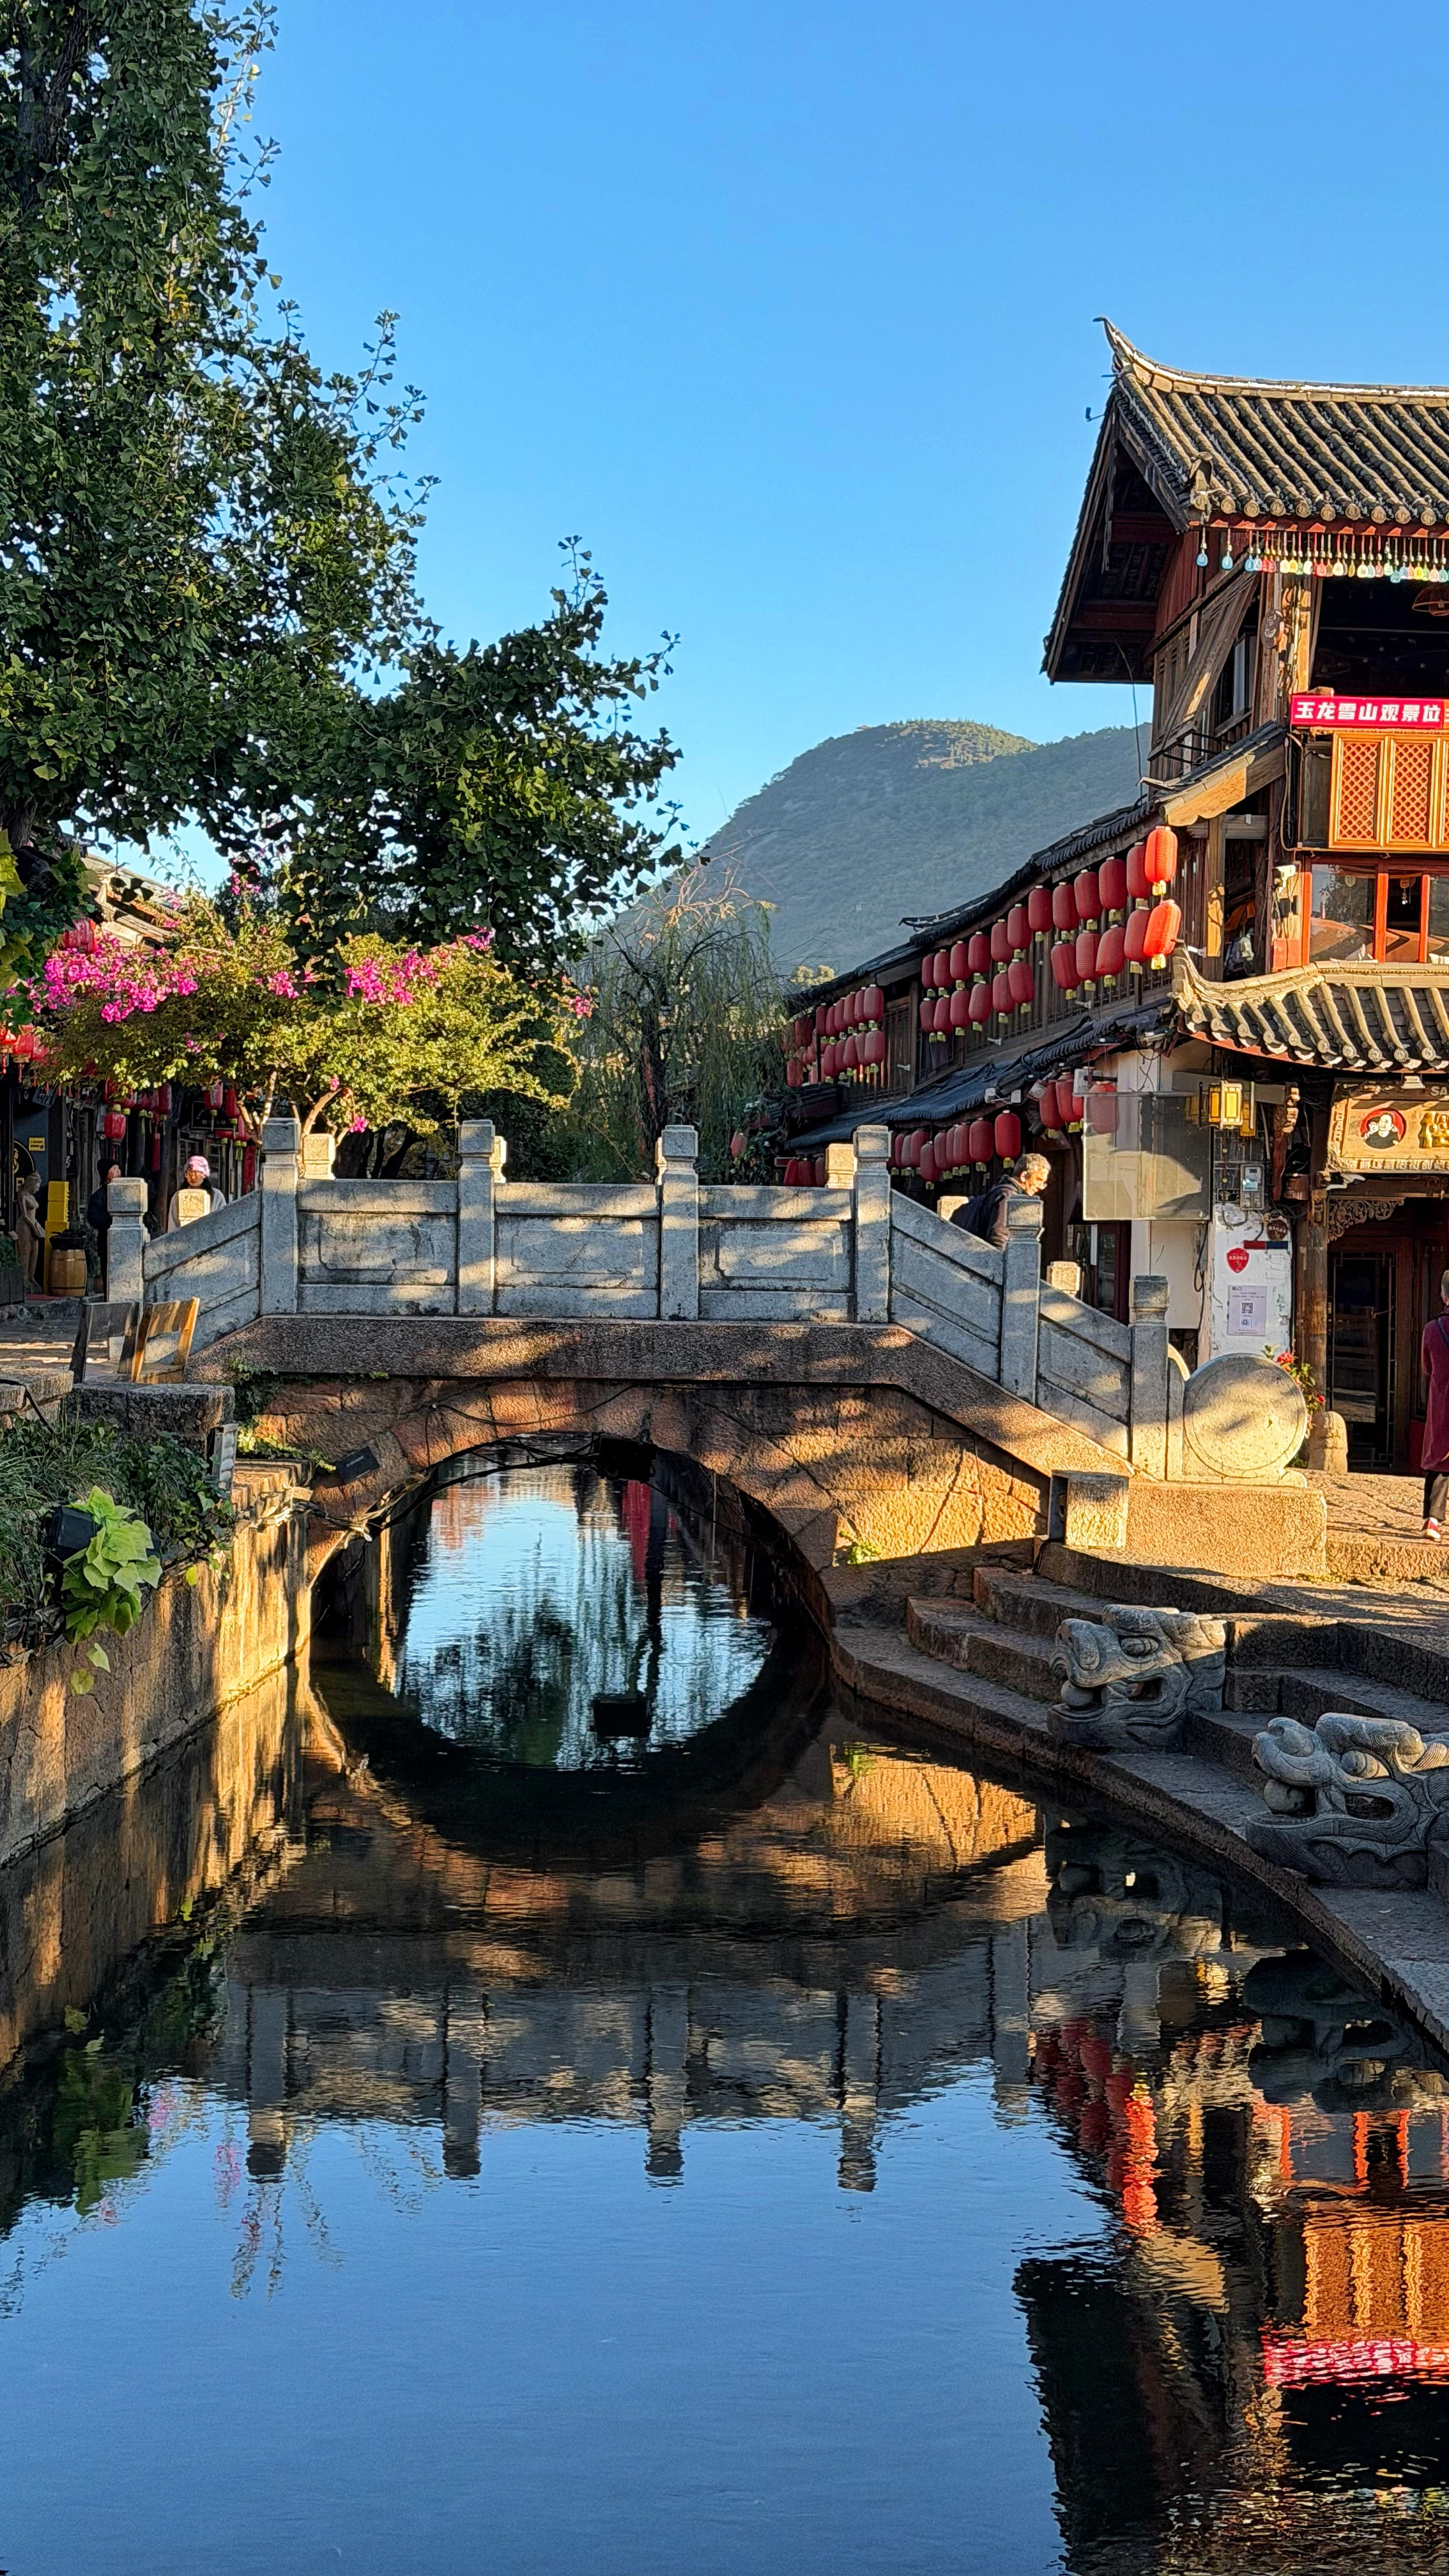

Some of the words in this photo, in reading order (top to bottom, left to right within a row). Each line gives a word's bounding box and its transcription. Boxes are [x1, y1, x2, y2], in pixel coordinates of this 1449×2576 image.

[1294, 702, 1441, 722] 玉龙雪山观景位
[1430, 1086, 1448, 1096] SA
